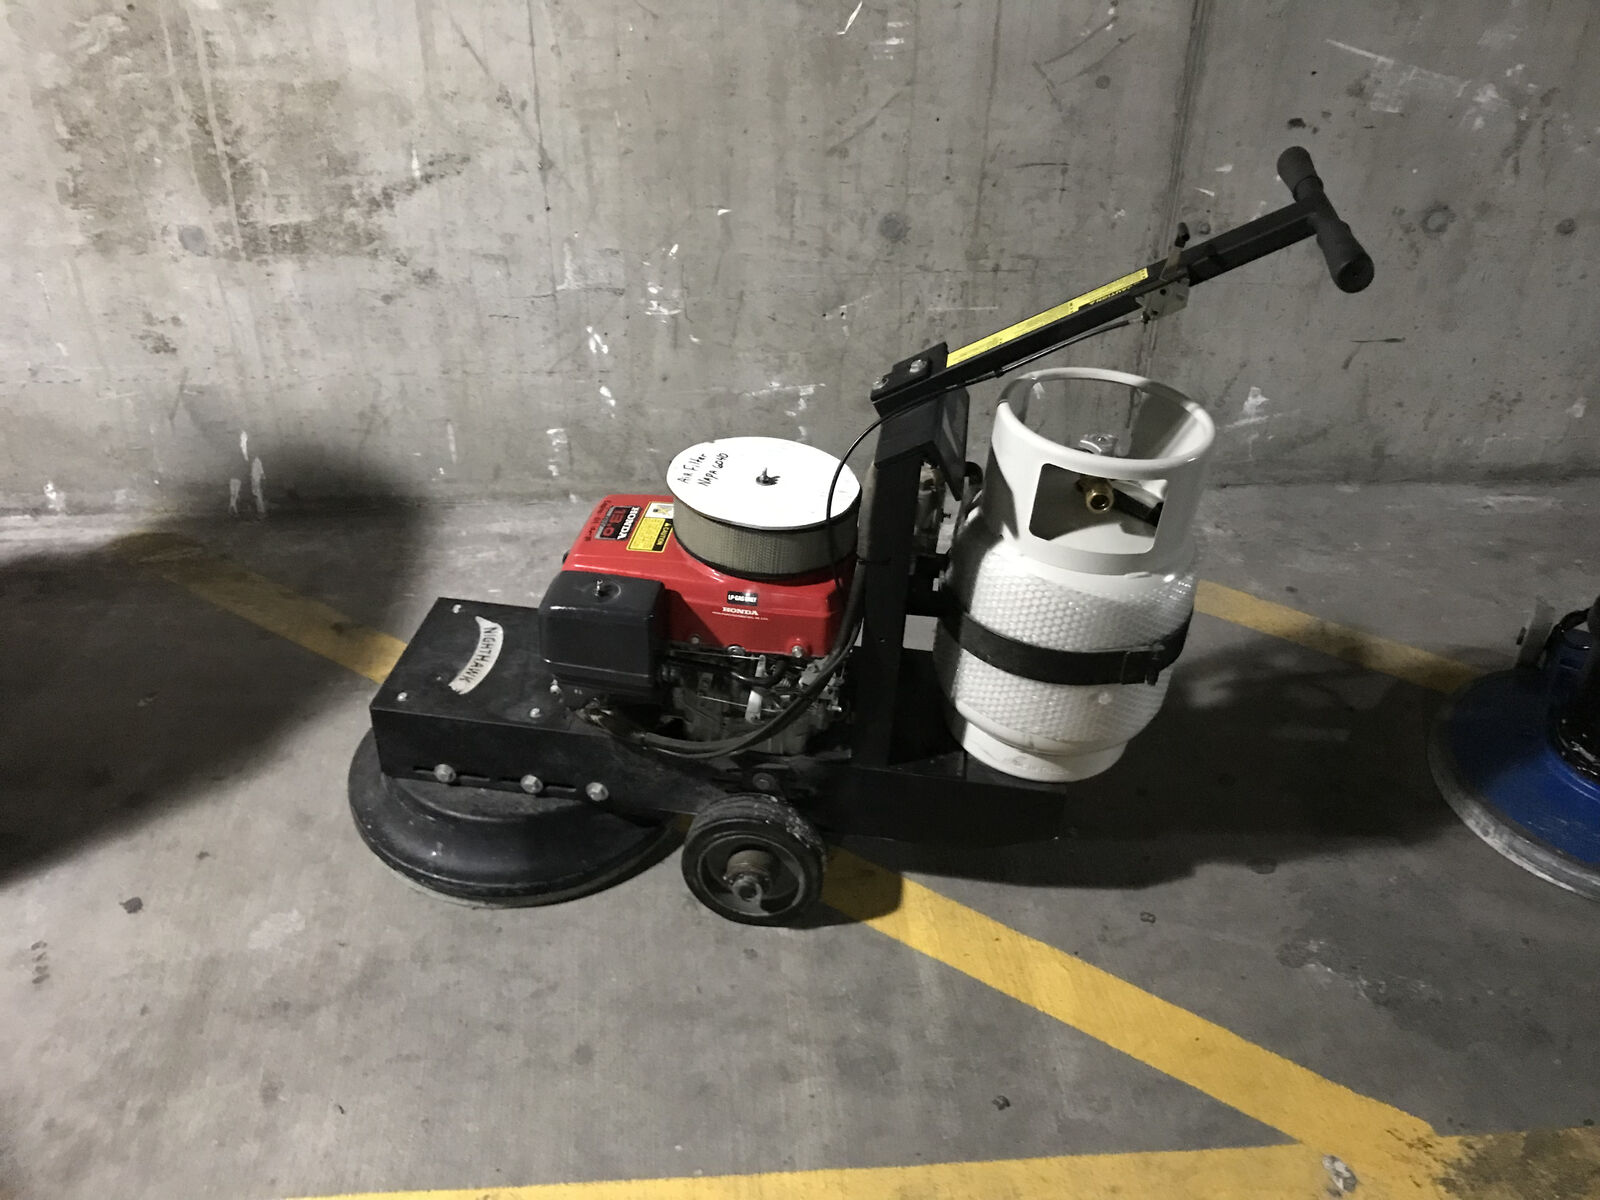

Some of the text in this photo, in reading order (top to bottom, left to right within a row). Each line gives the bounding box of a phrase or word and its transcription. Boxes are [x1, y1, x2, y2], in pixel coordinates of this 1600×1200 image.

[617, 506, 640, 540] HONDA
[722, 607, 759, 615] HONDA
[458, 626, 498, 684] NIGHTHAWK
